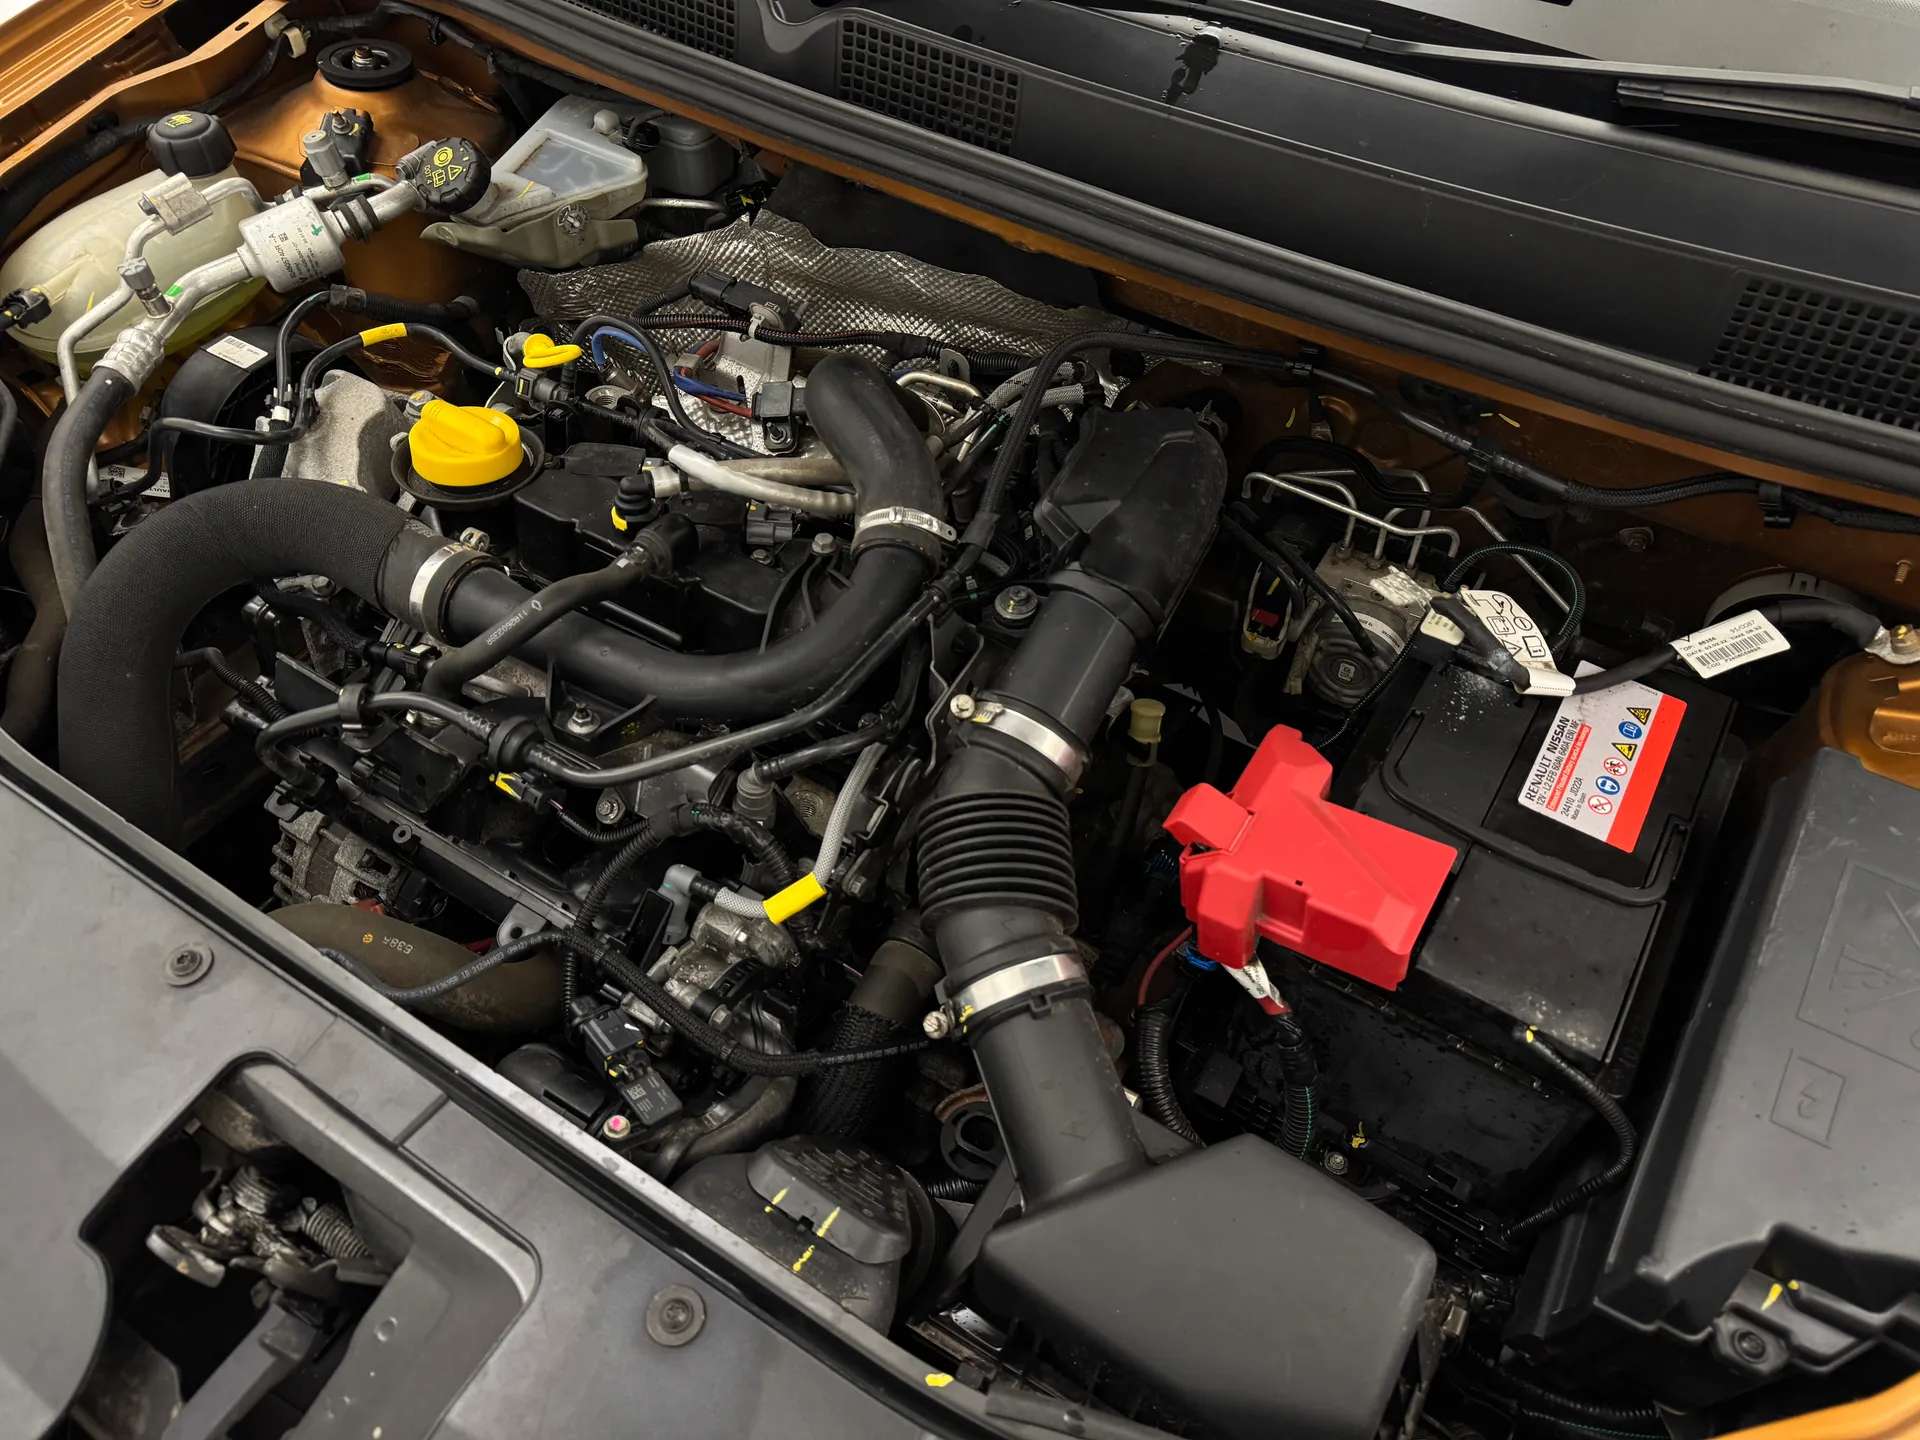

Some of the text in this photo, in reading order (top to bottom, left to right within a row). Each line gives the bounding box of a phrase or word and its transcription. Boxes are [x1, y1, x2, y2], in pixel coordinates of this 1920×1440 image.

[1523, 715, 1570, 801] RENAULT NISSAN
[1535, 793, 1546, 806] 12V
[1542, 781, 1552, 791] L2
[1559, 795, 1575, 817] 24410
